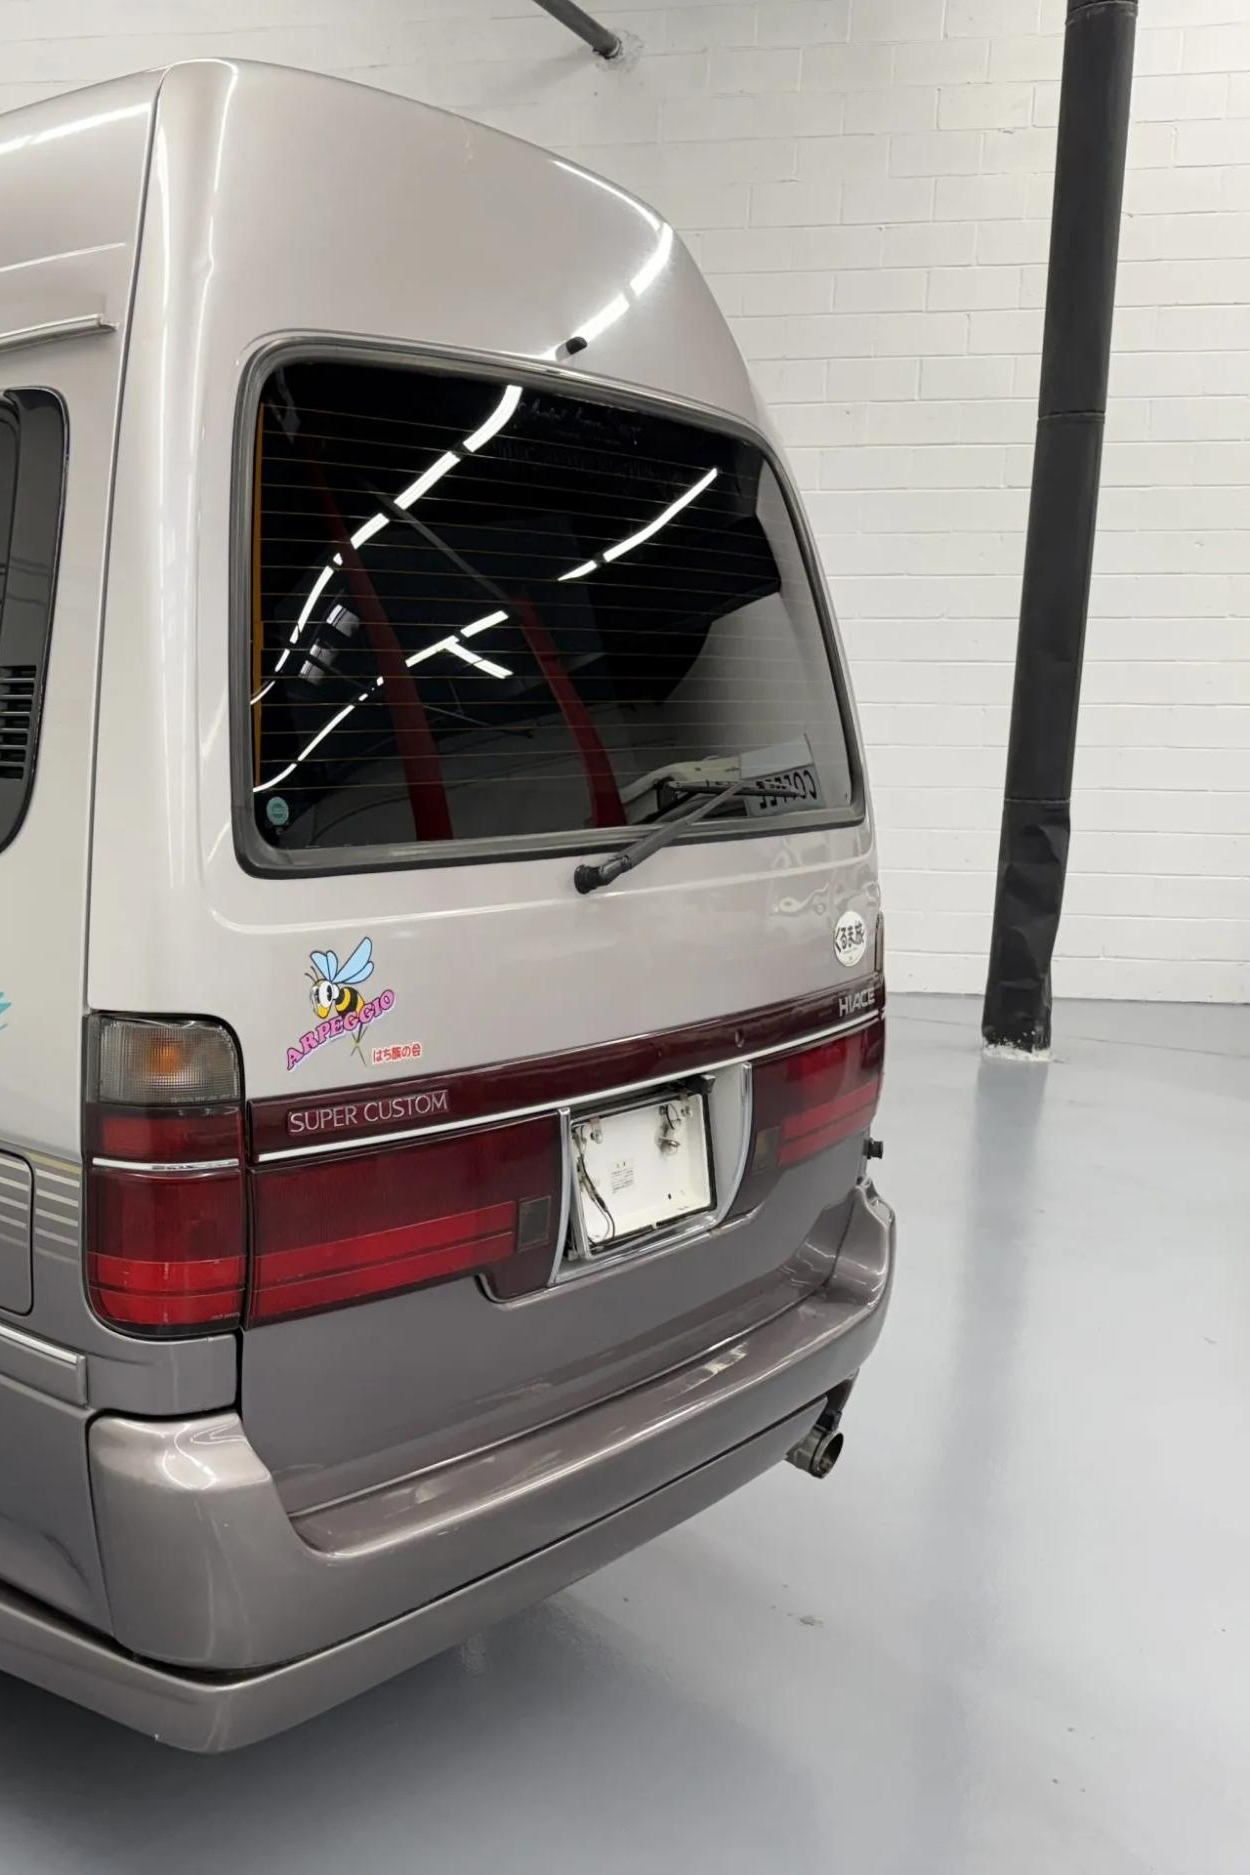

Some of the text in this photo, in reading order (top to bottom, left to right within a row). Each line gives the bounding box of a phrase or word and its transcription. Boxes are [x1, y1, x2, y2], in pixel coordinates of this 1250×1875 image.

[839, 987, 876, 1017] HIACE
[287, 989, 396, 1071] ARPEGGIO
[289, 1090, 448, 1133] SUPER CUSTOM
